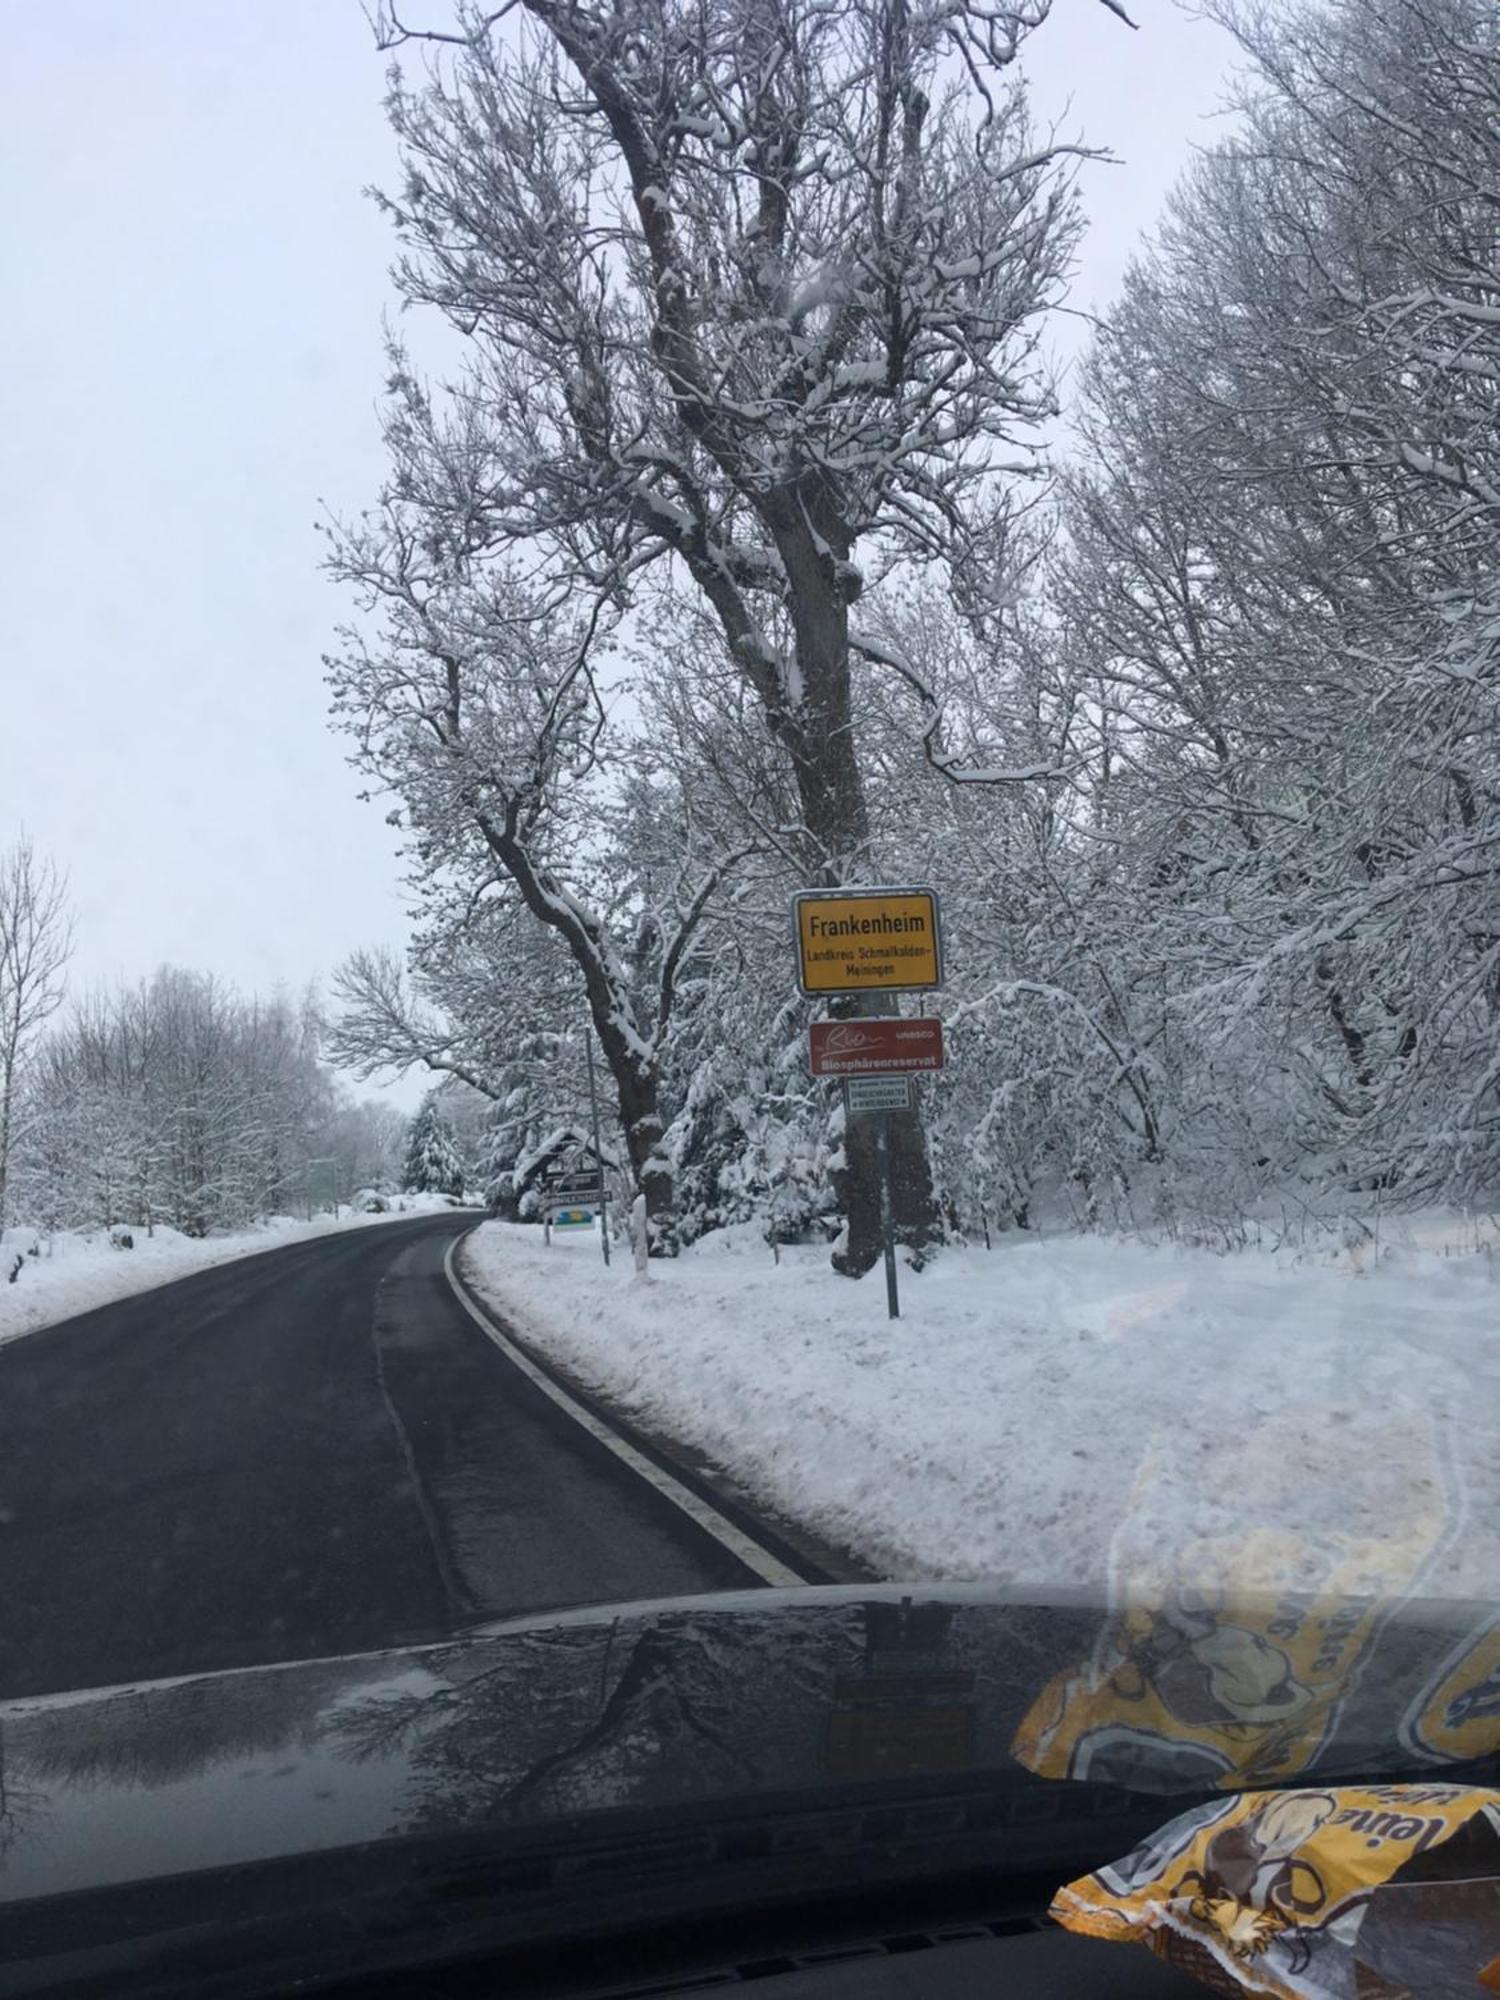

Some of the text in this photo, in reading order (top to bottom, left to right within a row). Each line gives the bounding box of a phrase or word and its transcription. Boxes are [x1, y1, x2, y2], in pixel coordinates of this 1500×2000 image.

[810, 911, 925, 937] Frankenheim
[807, 949, 854, 962] Landkreis
[846, 963, 895, 978] Meiningen
[821, 1056, 937, 1072] Biosphärenreservat
